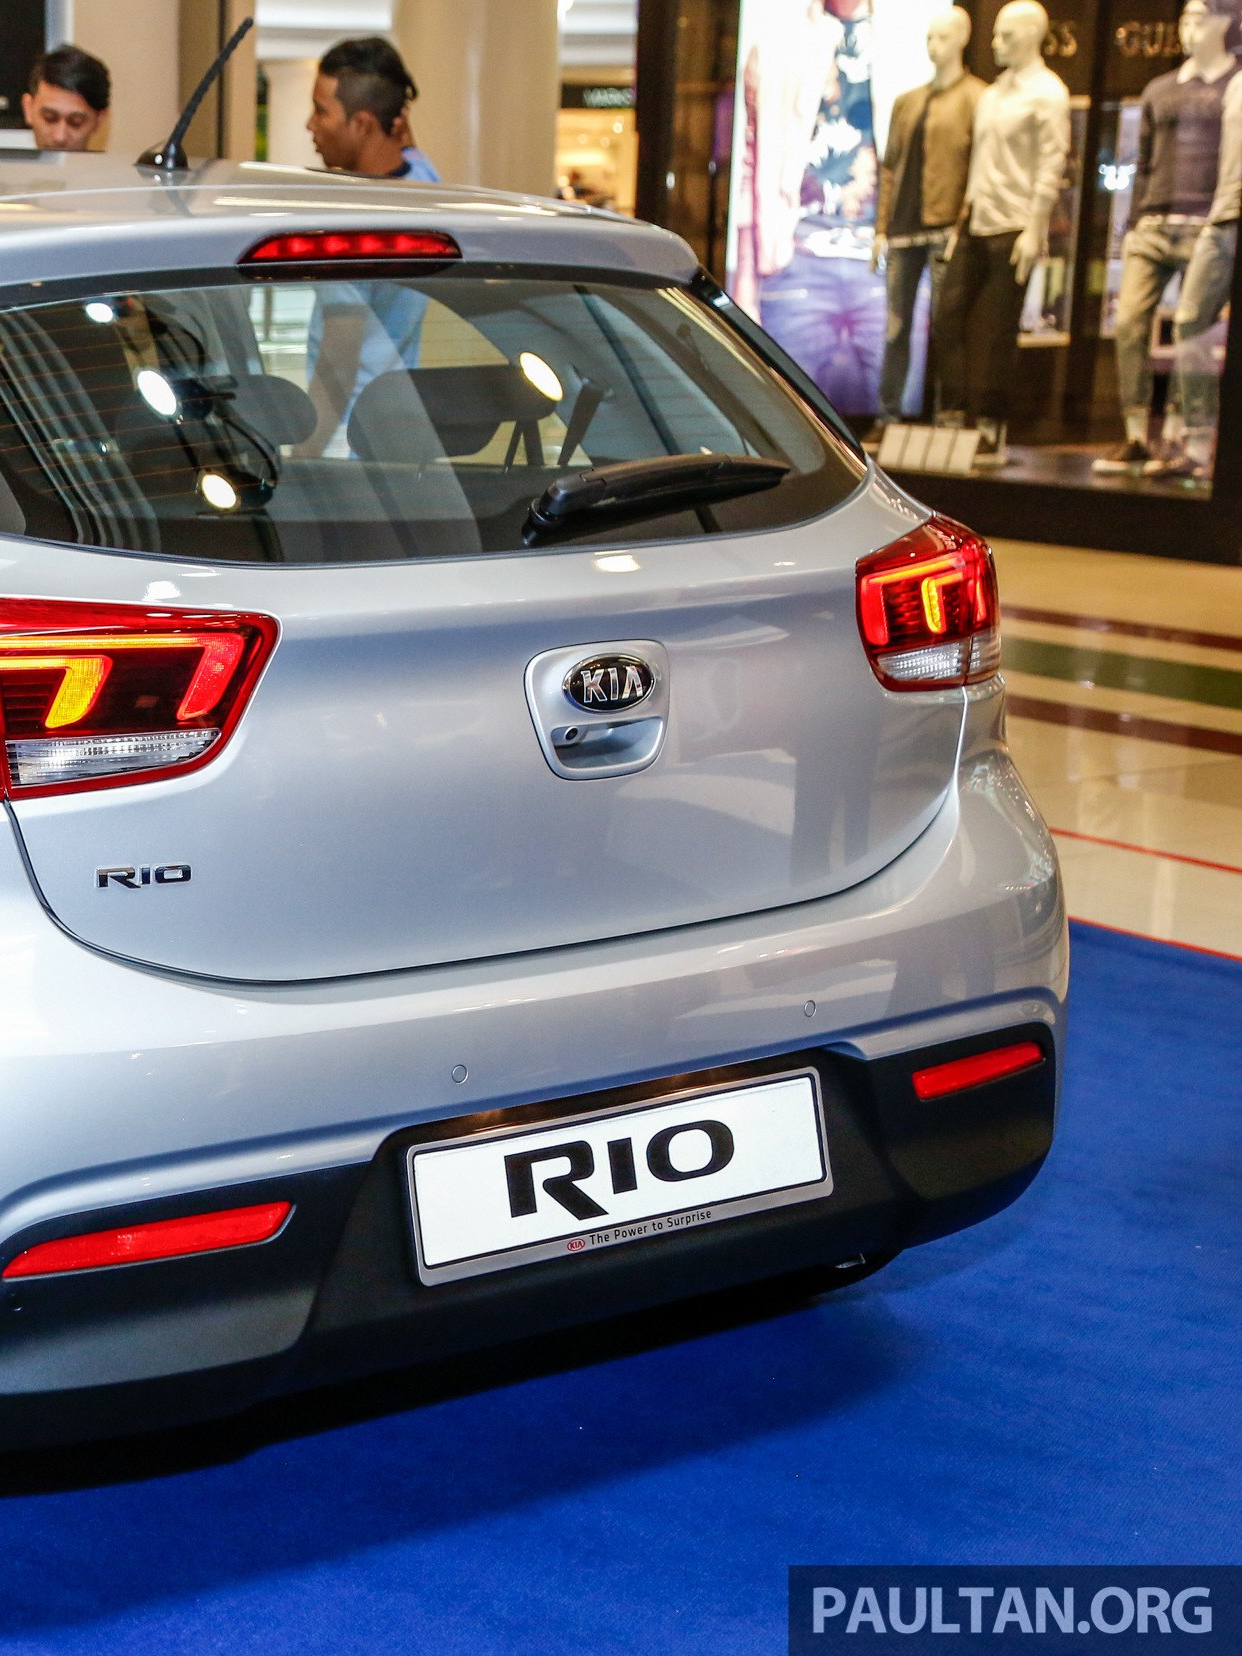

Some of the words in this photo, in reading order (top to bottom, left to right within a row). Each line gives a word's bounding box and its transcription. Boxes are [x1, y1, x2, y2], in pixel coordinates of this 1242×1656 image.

[581, 666, 643, 703] KIA
[95, 864, 192, 889] RIO
[504, 1119, 734, 1221] RIO
[568, 1239, 584, 1250] KIA
[589, 1233, 610, 1245] The
[614, 1225, 648, 1240] Power
[652, 1221, 663, 1231] to
[667, 1210, 712, 1228] Surprise
